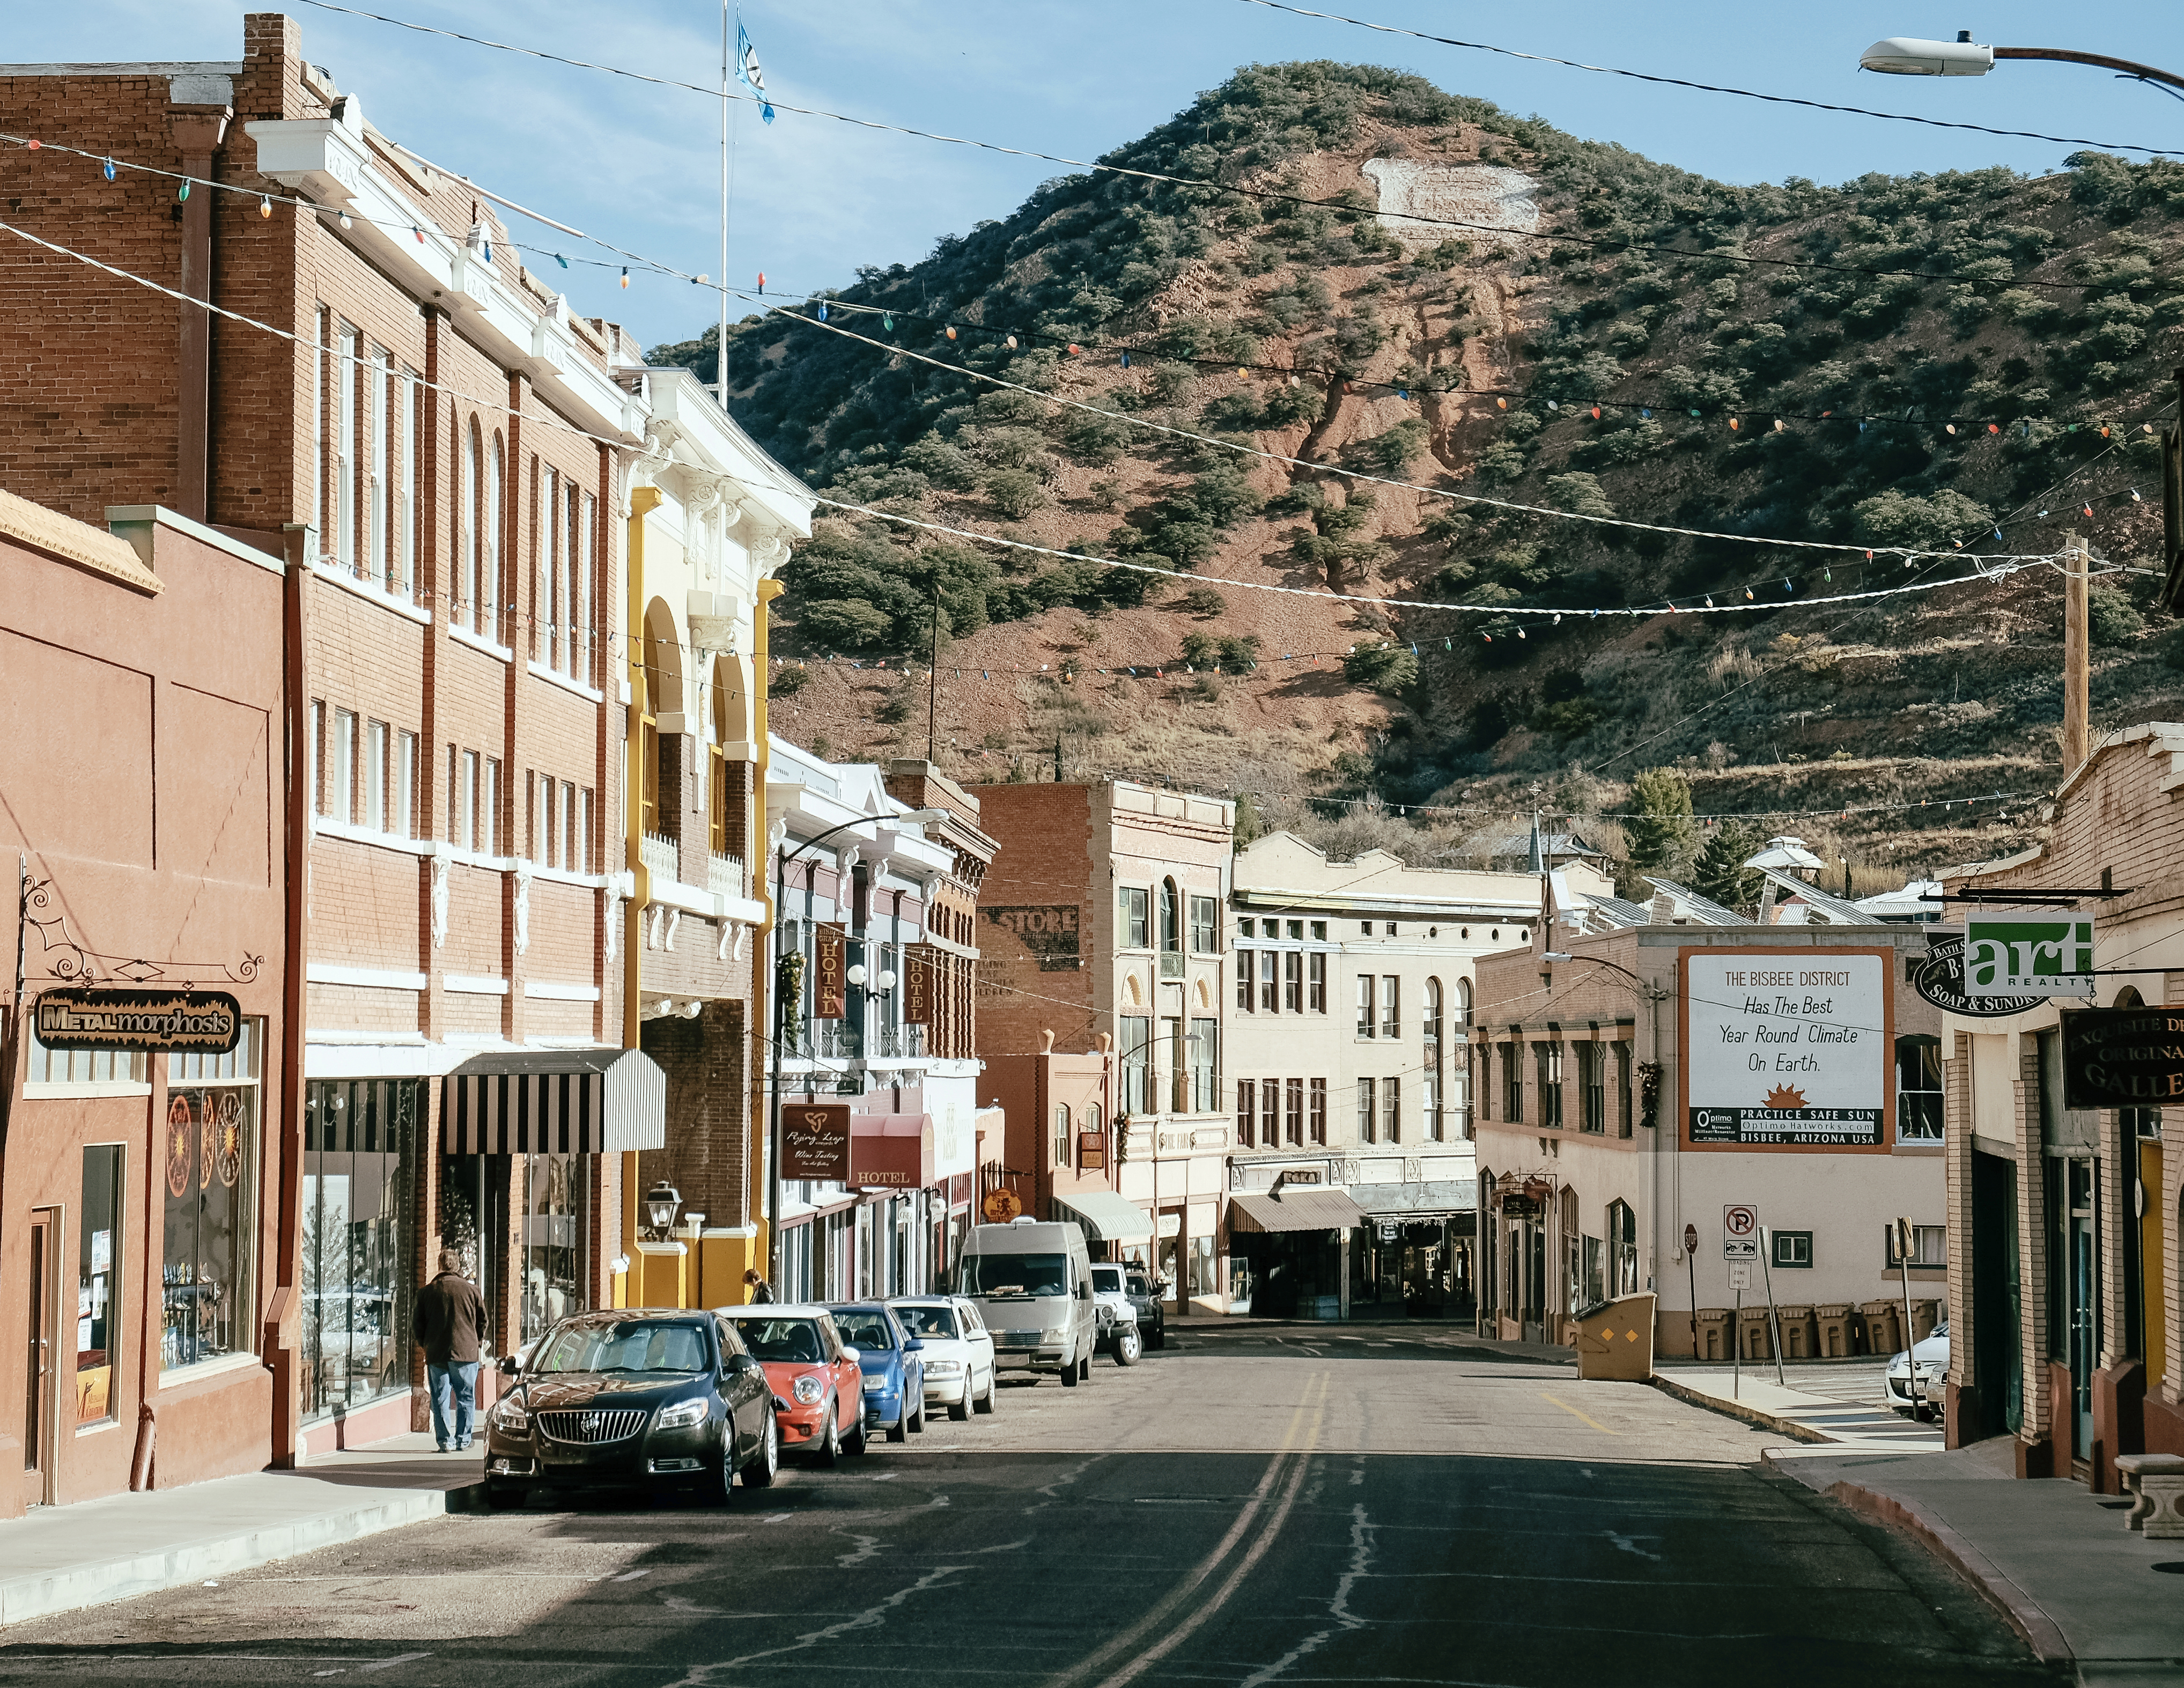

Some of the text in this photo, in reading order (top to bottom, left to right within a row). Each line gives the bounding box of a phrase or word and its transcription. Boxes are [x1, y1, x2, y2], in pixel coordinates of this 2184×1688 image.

[1000, 911, 1078, 933] STORE
[1933, 943, 1959, 959] BATH
[1969, 922, 2092, 986] art
[822, 943, 837, 1014] HOTEL
[1725, 971, 1851, 986] THE BISBEE DISTRICT
[910, 961, 924, 1020] HOTEL
[1929, 984, 2043, 1011] SOAP & SUNDR
[1744, 996, 1833, 1014] Has The Best
[1720, 1024, 1858, 1043] Year Round Climate
[2070, 1018, 2161, 1053] EXQUISITE
[1749, 1053, 1820, 1072] On Earth.
[1741, 1109, 1875, 1121] PRACTICE SAFE SUN
[1164, 1132, 1189, 1151] THE FAIR
[1741, 1133, 1875, 1144] BISBEE, ARIZONA USA
[794, 1150, 839, 1162] Wine Tasting
[858, 1172, 910, 1184] HOTEL
[1686, 1233, 1697, 1245] STOP
